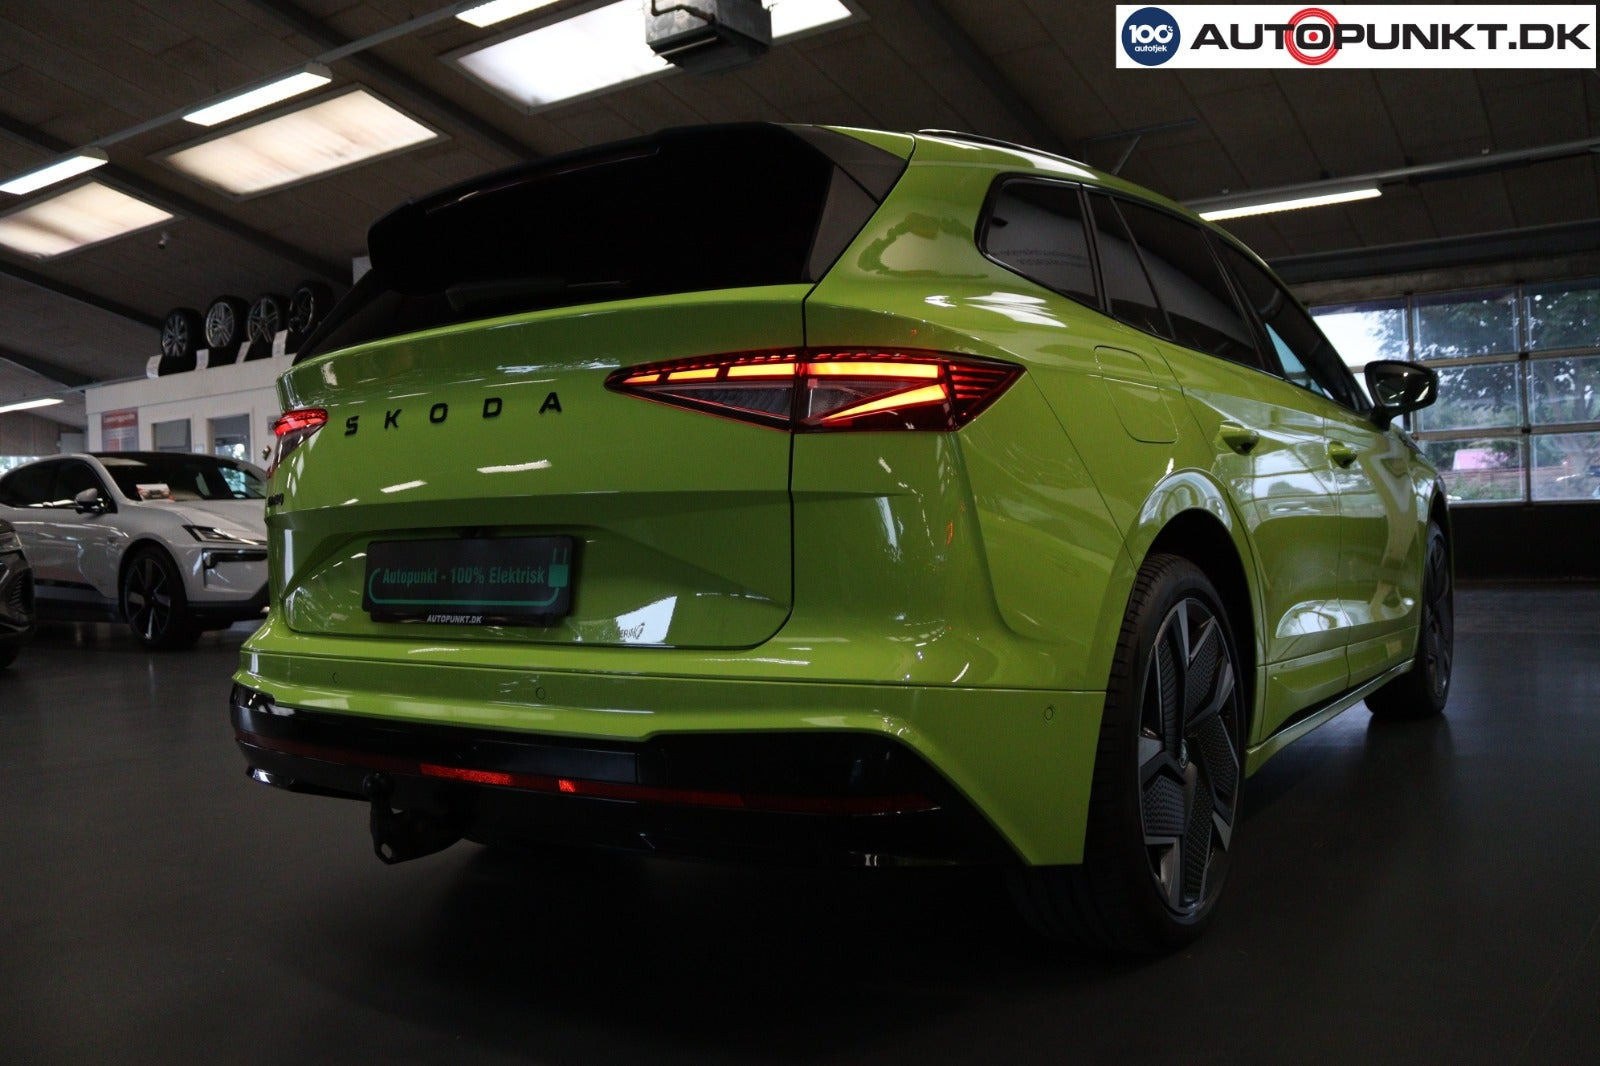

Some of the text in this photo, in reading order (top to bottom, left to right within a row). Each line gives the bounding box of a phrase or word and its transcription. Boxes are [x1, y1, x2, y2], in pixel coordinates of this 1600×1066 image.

[344, 391, 562, 436] SKODA
[382, 567, 438, 588] Autopunkt
[450, 566, 485, 585] 100%
[488, 565, 545, 585] Elektrisk
[426, 613, 484, 624] AUTOPUNKT.DK
